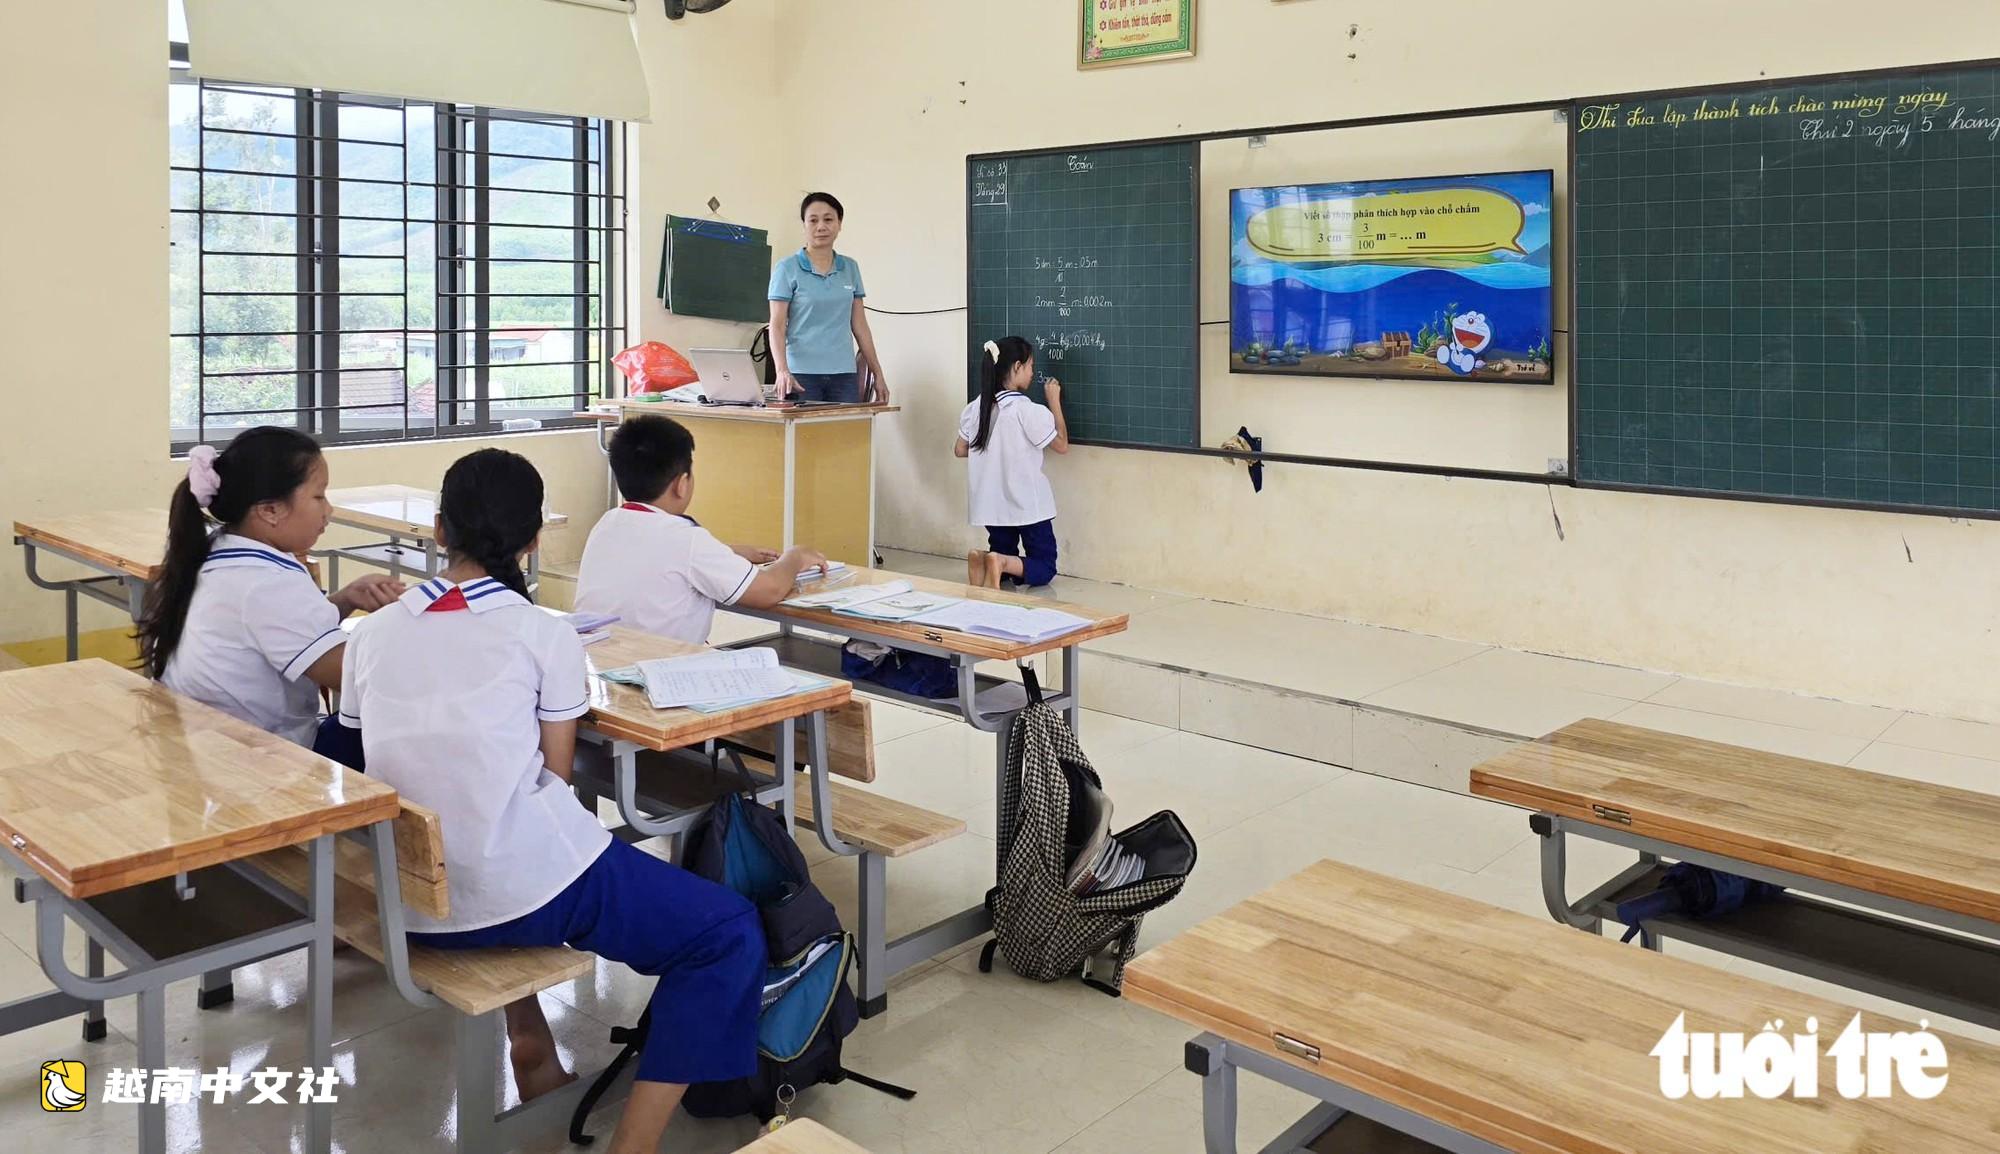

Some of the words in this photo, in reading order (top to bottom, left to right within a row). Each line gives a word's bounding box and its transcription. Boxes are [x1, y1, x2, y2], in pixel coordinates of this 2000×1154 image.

[1577, 103, 1620, 133] Thi
[1626, 106, 1655, 128] đua
[1663, 103, 1687, 128] lập
[1693, 98, 1740, 121] thành
[1748, 96, 1780, 116] tích
[1788, 95, 1825, 113] chào
[1832, 94, 1887, 117] mừng
[1894, 87, 1956, 115] ngày
[1842, 119, 1853, 138] 2
[1921, 115, 1936, 133] 5
[1067, 155, 1094, 171] Toán
[1353, 209, 1374, 220] phân
[1376, 208, 1397, 217] thích
[1400, 207, 1417, 218] hợp
[1420, 206, 1435, 215] vào
[1455, 202, 1480, 213] chấm
[1363, 222, 1369, 232] 3
[1416, 231, 1426, 239] m
[1358, 240, 1375, 249] 100
